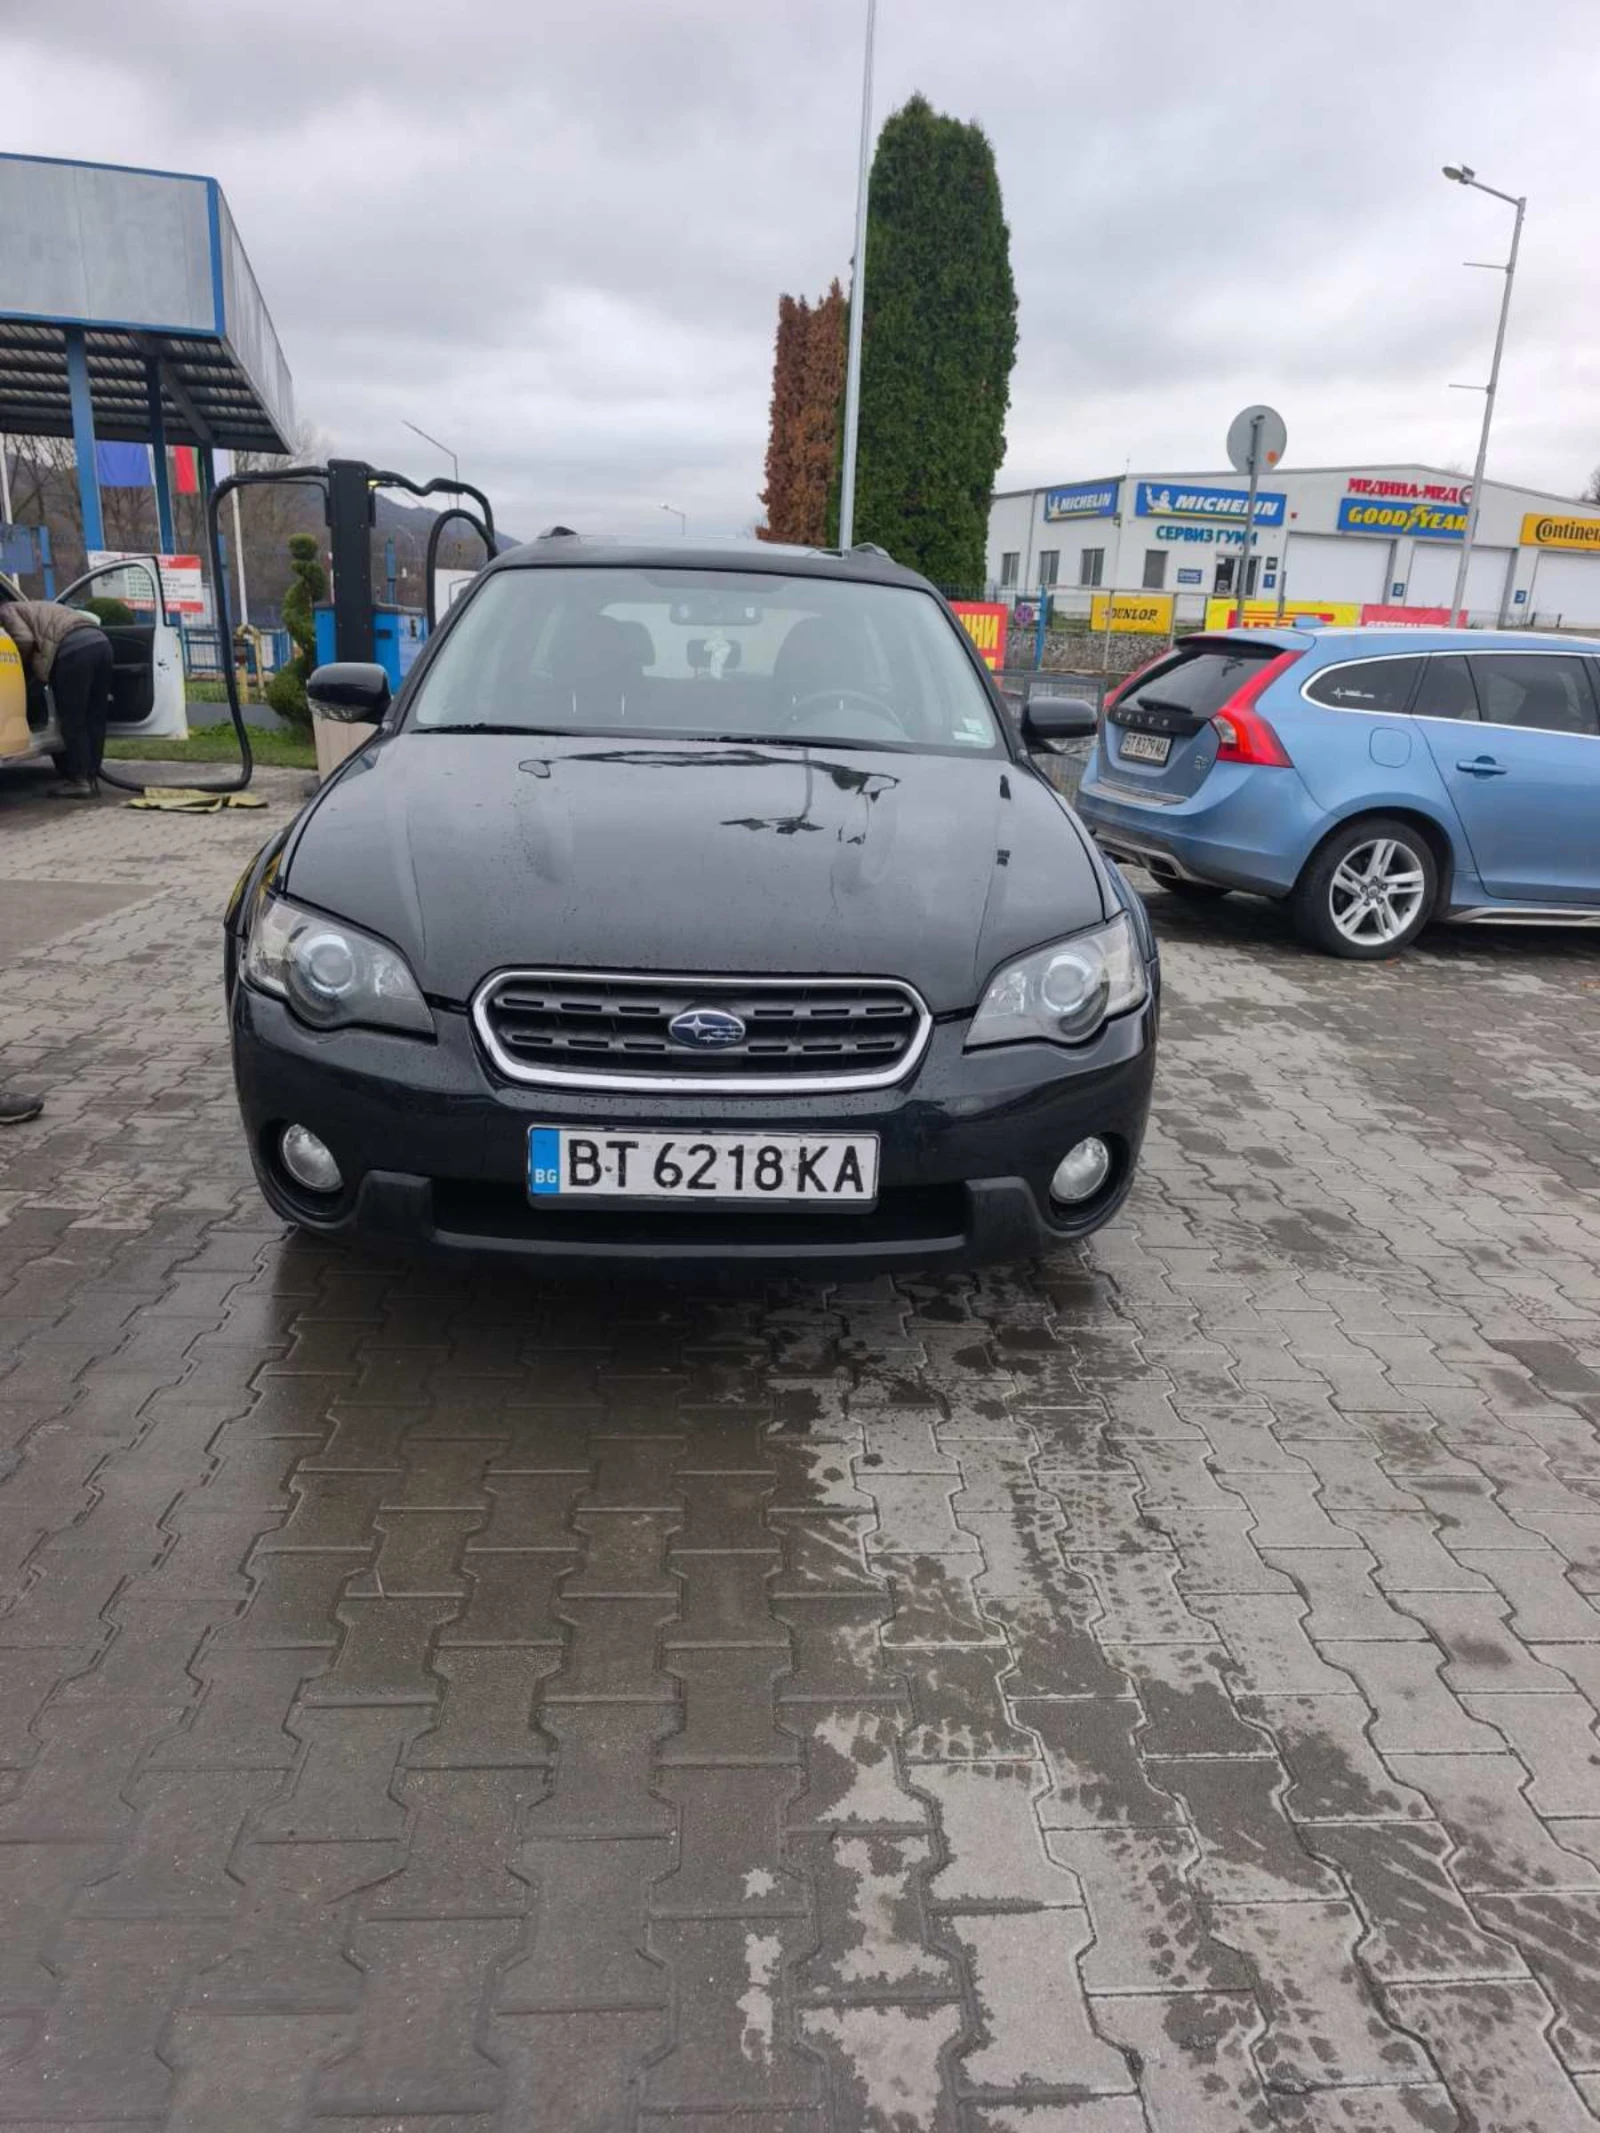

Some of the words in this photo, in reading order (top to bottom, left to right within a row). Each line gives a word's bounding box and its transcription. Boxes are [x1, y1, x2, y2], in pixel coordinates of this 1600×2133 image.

[1060, 492, 1112, 511] MICHELIN
[1156, 525, 1214, 544] СЕРВИЗ
[568, 1139, 639, 1187] BT
[653, 1142, 783, 1192] 6218
[796, 1146, 864, 1193] KA
[534, 1169, 557, 1183] BG
